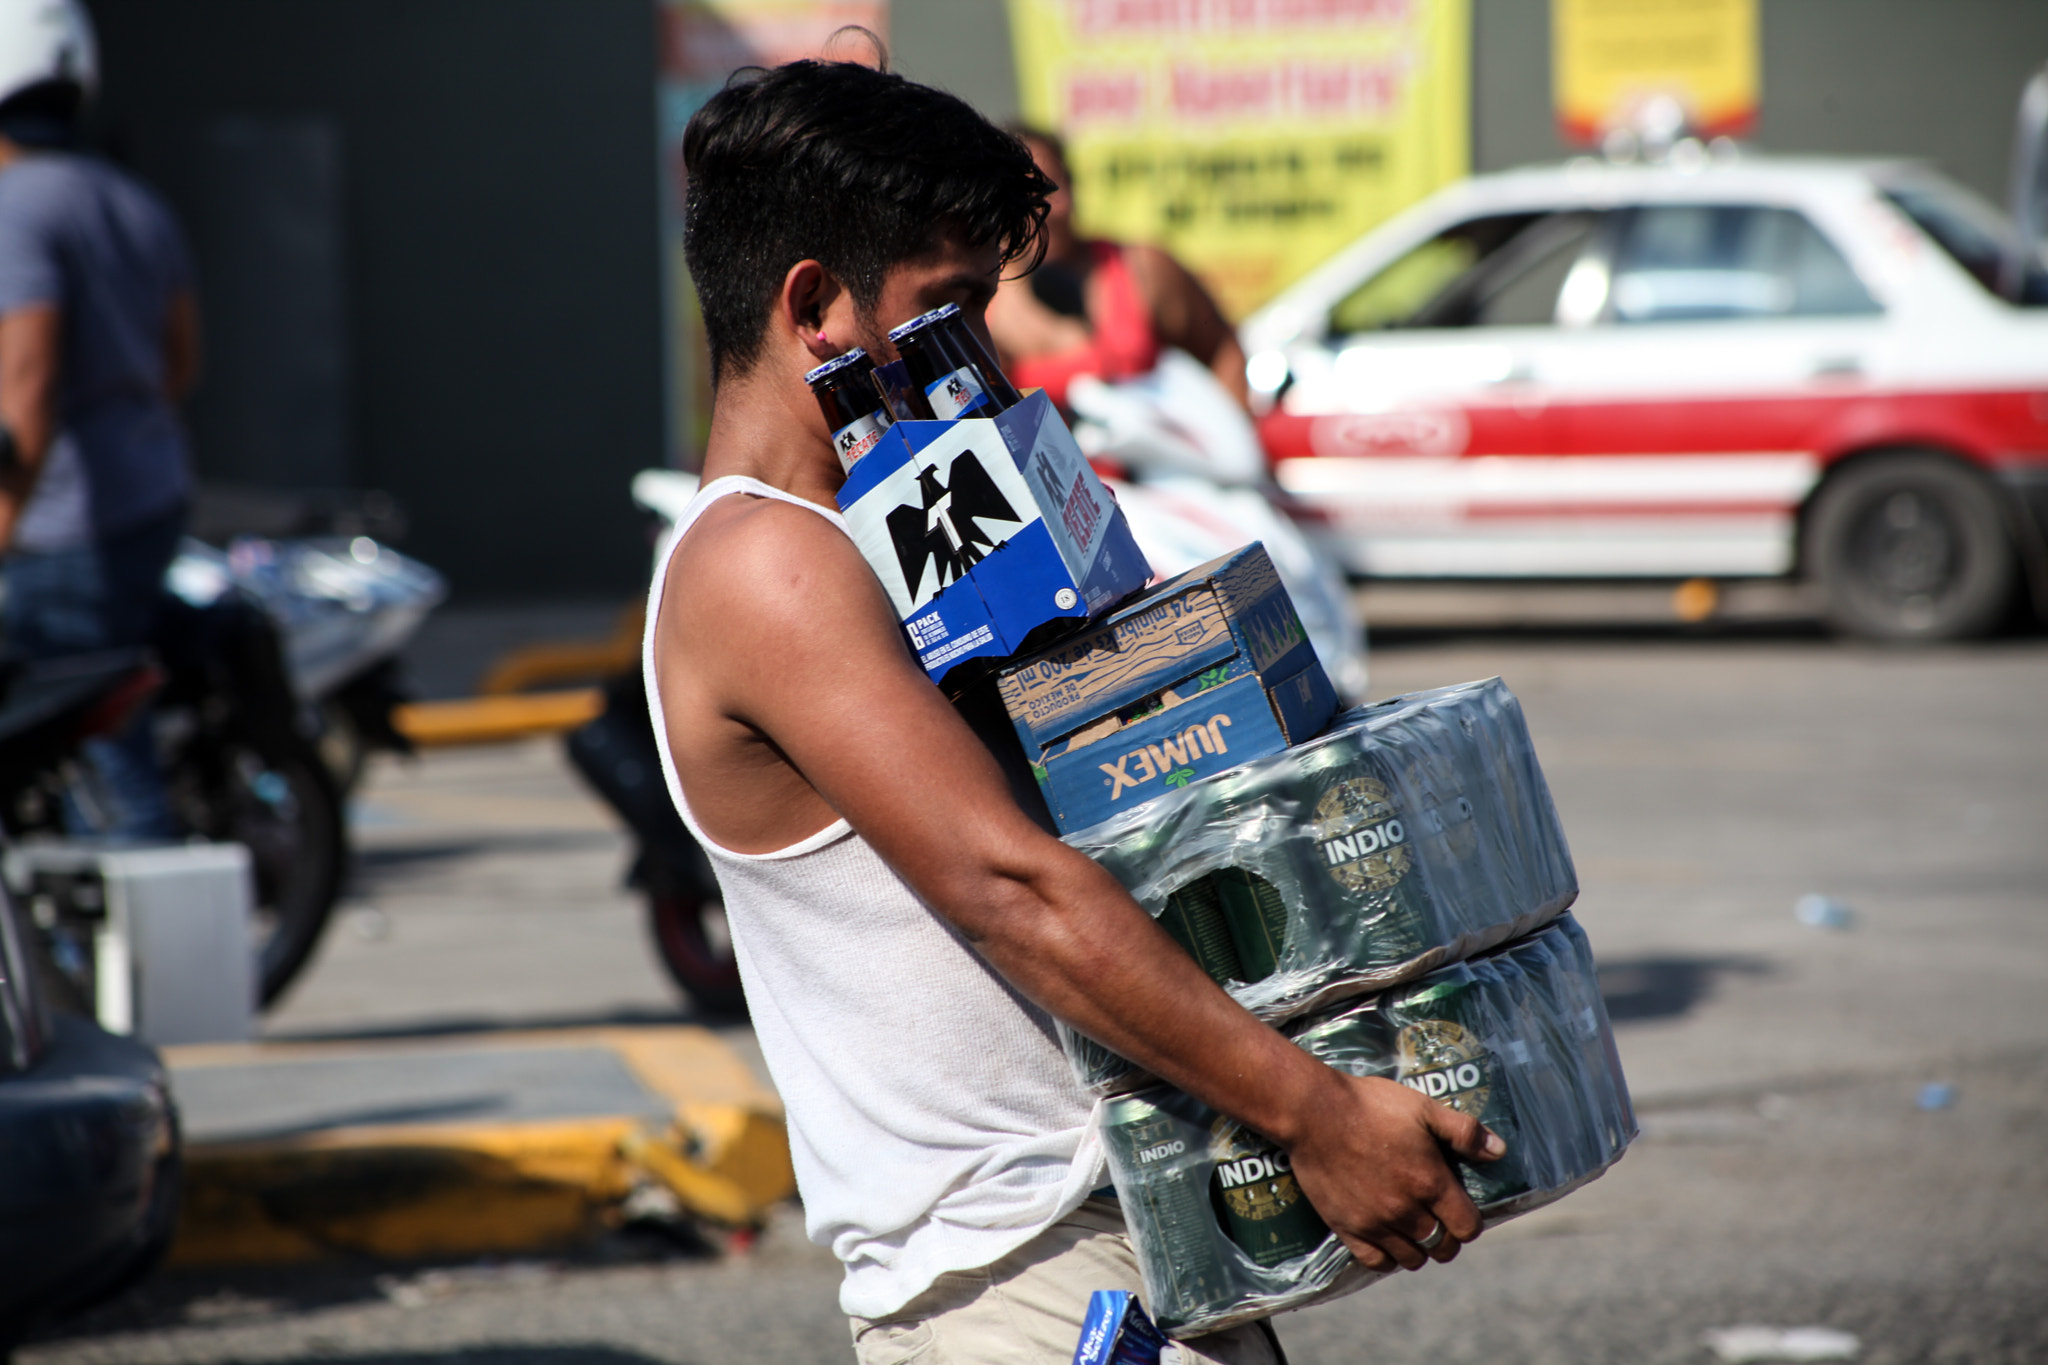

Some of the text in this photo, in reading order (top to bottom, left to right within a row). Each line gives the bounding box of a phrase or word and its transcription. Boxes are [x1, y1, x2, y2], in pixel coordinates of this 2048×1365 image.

[846, 430, 880, 462] TECATE
[1062, 470, 1101, 554] TECATE
[915, 611, 941, 630] PACK
[1096, 604, 1169, 653] minibriks
[906, 622, 926, 651] 6
[1040, 651, 1072, 680] 200
[1074, 641, 1093, 662] de
[1016, 667, 1037, 692] ml
[1064, 682, 1077, 694] DE
[1032, 692, 1080, 719] PRODUCTO
[1098, 714, 1232, 801] JUMEX
[1324, 819, 1405, 865] INDIO
[1402, 1063, 1480, 1097] NDIO
[1140, 1140, 1185, 1164] INDIO
[1218, 1151, 1292, 1188] INDIO
